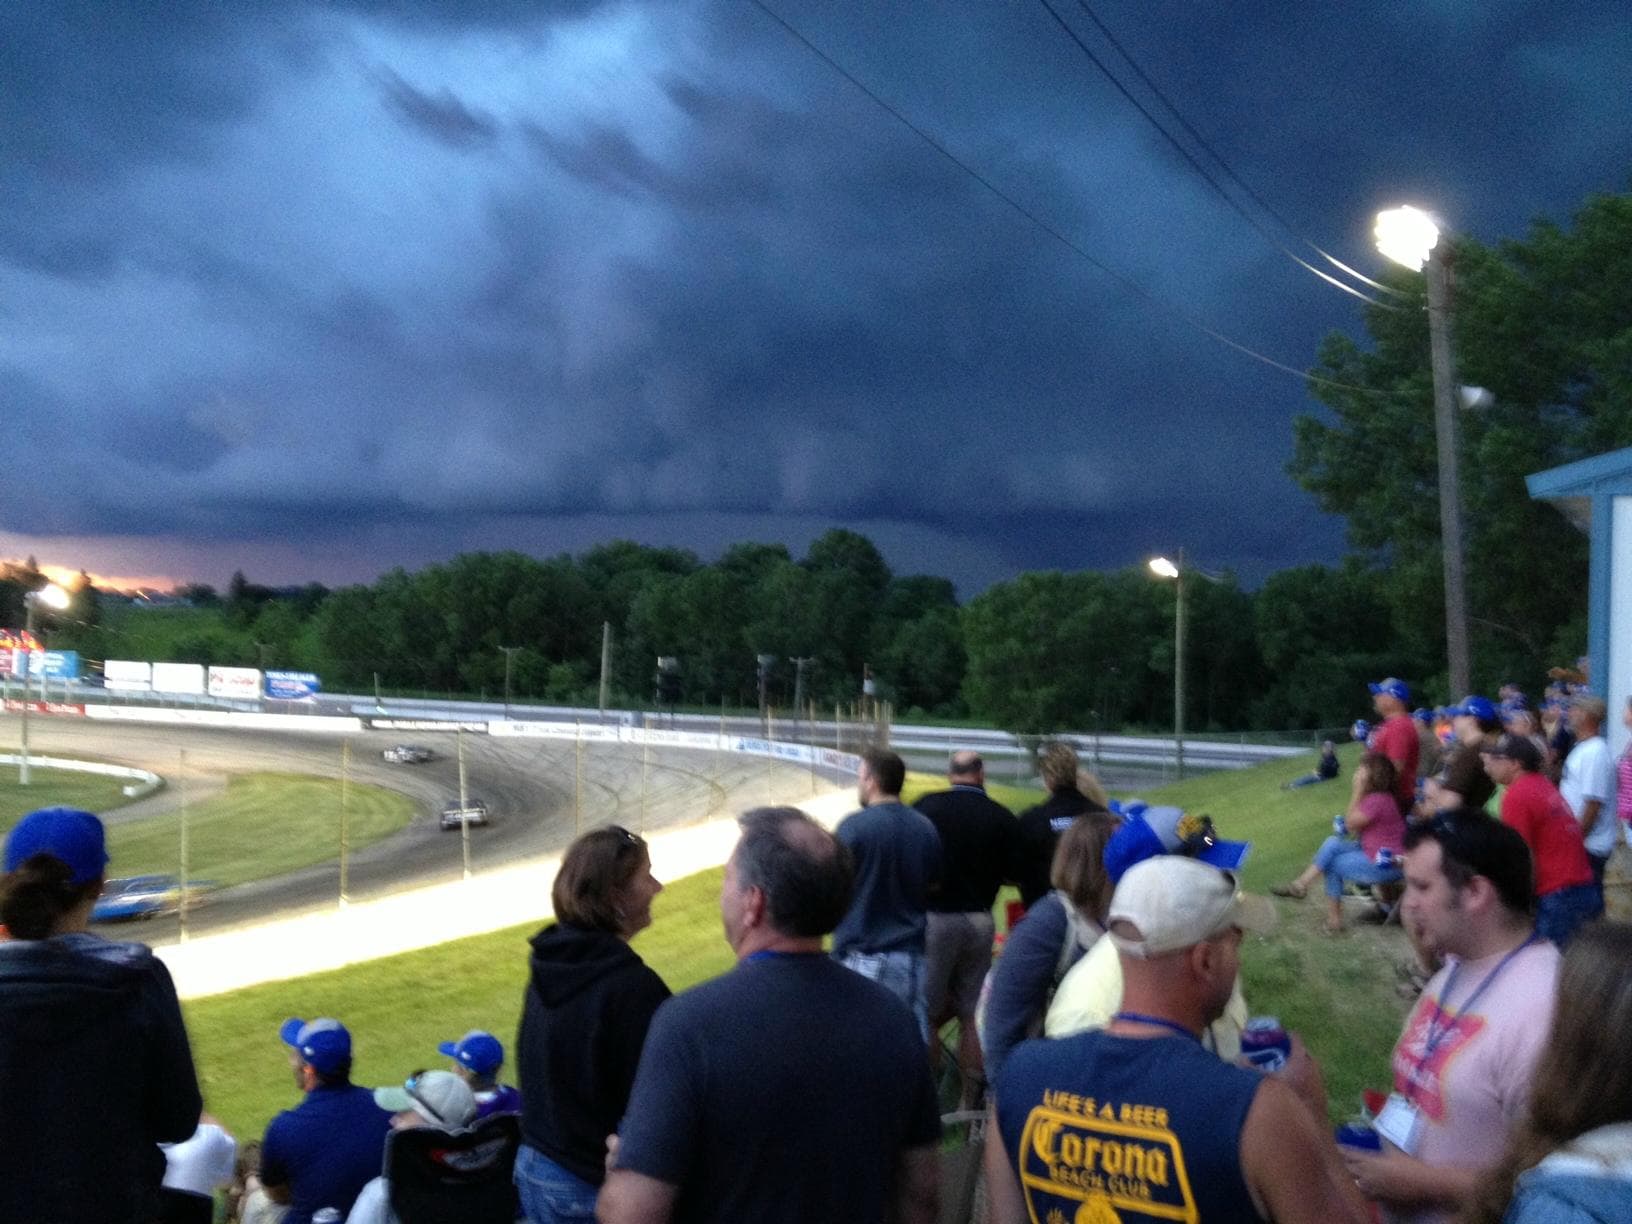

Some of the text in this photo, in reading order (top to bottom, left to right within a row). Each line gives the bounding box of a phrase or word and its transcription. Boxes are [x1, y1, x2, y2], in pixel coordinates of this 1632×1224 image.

[1044, 1088, 1096, 1117] LIFE'S
[1100, 1102, 1114, 1120] A
[1033, 1118, 1168, 1187] Corona
[1050, 1165, 1150, 1199] BEACH CLUB
